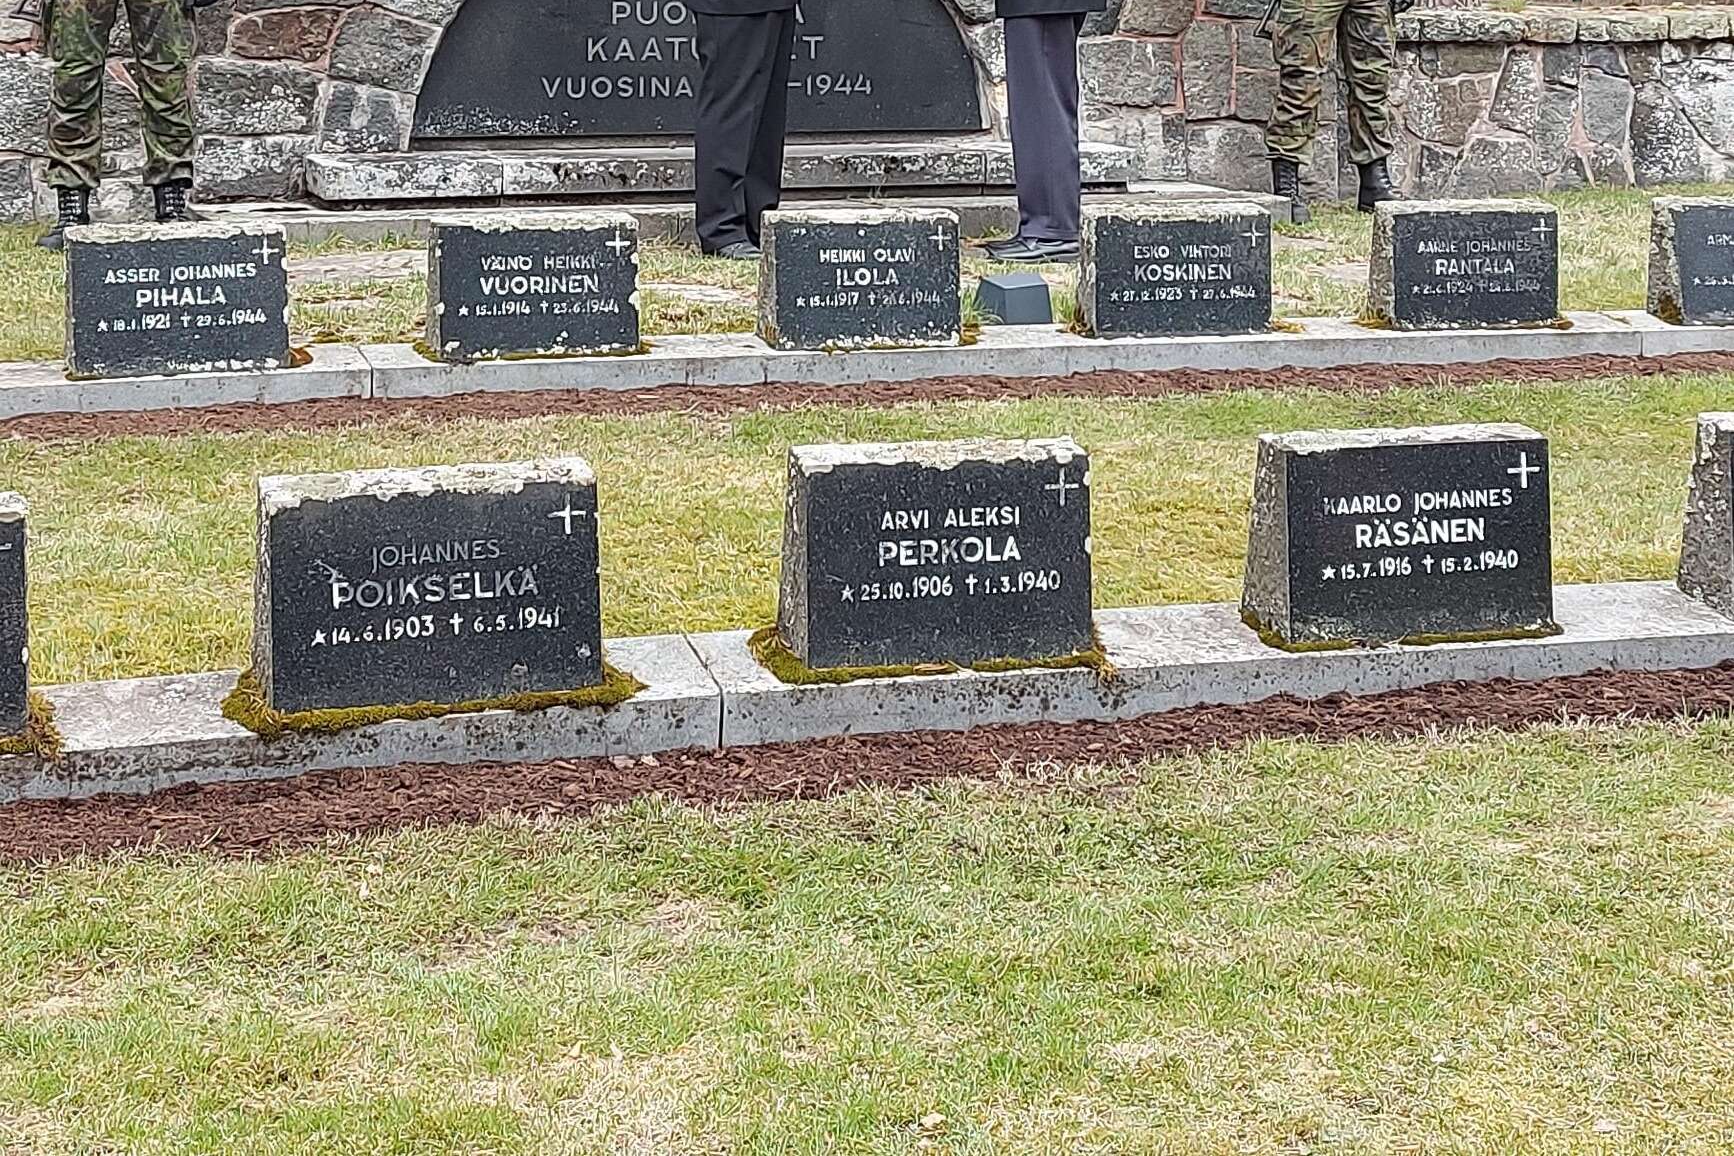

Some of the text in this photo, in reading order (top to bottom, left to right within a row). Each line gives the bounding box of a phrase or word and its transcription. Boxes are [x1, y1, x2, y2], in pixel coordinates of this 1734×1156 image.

[542, 75, 694, 98] VUOSINA
[819, 247, 916, 263] HEIKKI OLAVI
[1134, 244, 1232, 259] ESKO VIHTORI
[1466, 239, 1532, 255] JOHANNES
[104, 262, 257, 284] ASSER JOHANNES
[481, 254, 596, 271] VÄINÖ HEIKKI
[1134, 262, 1232, 282] KOSKINEN
[1435, 258, 1516, 276] RANTALA
[480, 273, 600, 295] VUORINEN
[836, 268, 900, 286] ILOLA
[136, 285, 227, 308] PIHALA
[810, 291, 859, 308] 15.1.1917
[476, 300, 531, 316] 15.1.1914
[113, 313, 170, 332] 18.1.1921
[1323, 488, 1513, 516] KAARLO JOHANNES
[881, 506, 1021, 530] ARVI ALEKSI
[1355, 516, 1485, 548] RÄSÄNEN
[371, 539, 500, 573] JOHANNES
[878, 535, 1022, 567] PERKOLA
[1340, 549, 1519, 580] 15.7.1916 15.2.1940
[332, 564, 540, 610] POIKSELKÄ
[860, 570, 1061, 601] 25.10.1906 1.3.1940
[332, 606, 561, 645] 14.6.1903 6.5.1941
